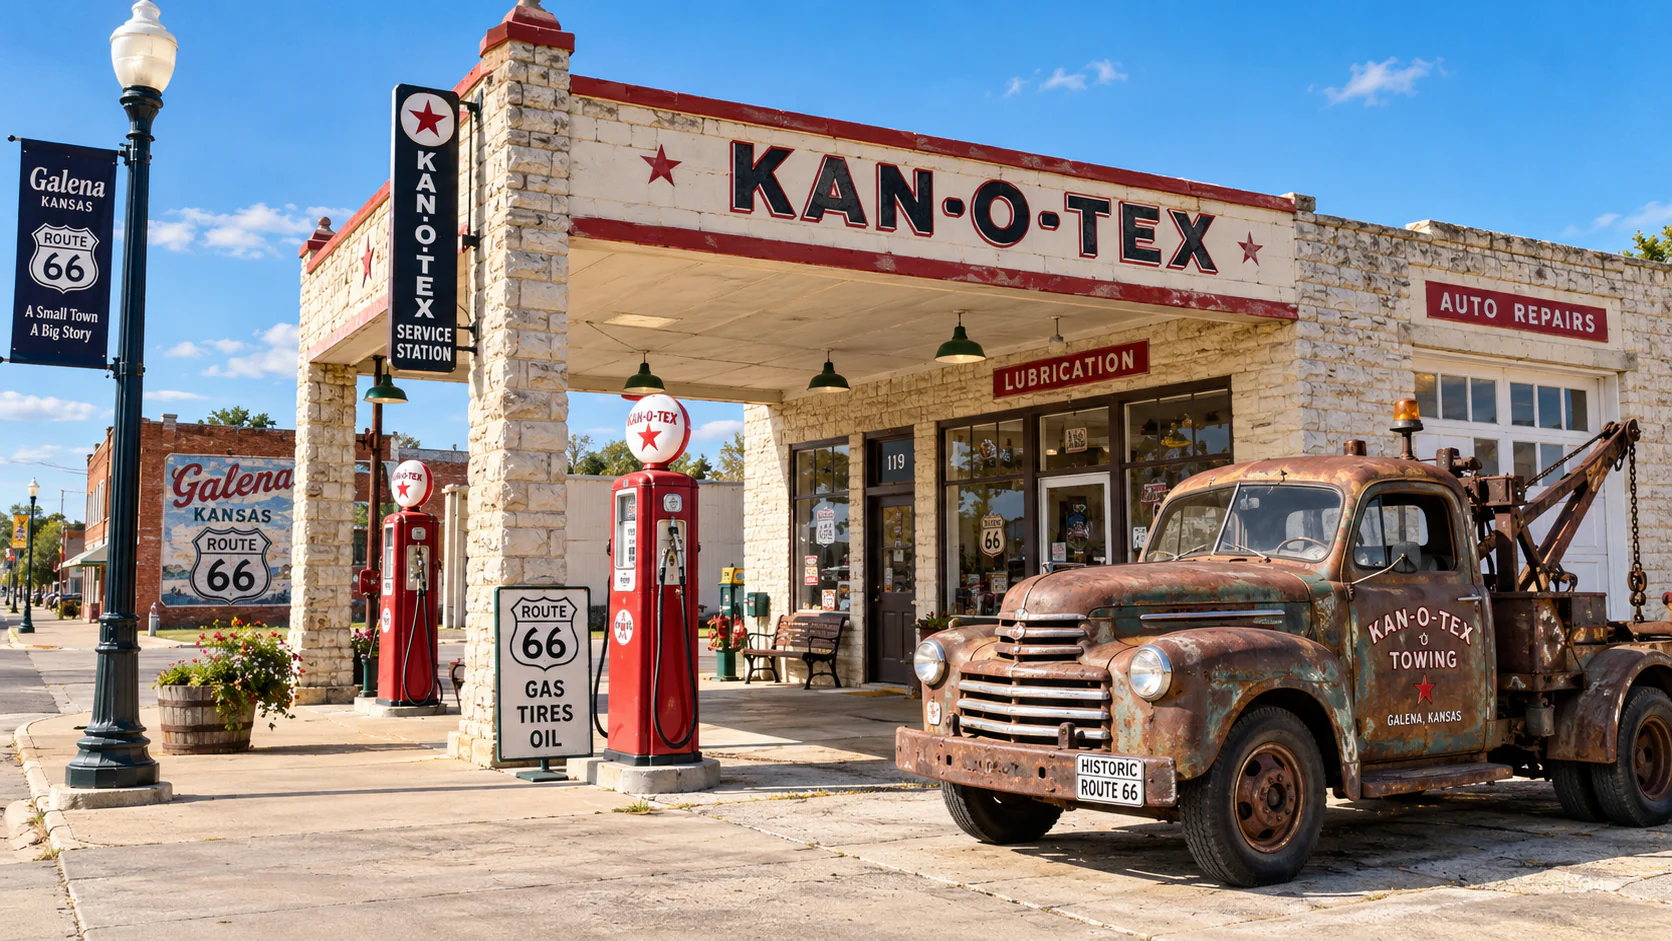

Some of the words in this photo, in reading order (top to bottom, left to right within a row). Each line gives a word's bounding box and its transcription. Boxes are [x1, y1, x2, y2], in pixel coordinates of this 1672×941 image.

[29, 166, 106, 198] Galena
[41, 195, 94, 213] KANSAS
[44, 231, 88, 247] ROUTE
[43, 251, 85, 283] 66
[24, 304, 34, 318] A
[36, 304, 67, 321] Small
[69, 307, 99, 324] Town
[1440, 291, 1498, 319] AUTO
[1514, 302, 1596, 333] REPAIRS
[30, 323, 39, 337] A
[41, 323, 60, 341] Big
[62, 325, 92, 344] Story
[396, 323, 452, 343] SERVICE
[396, 343, 452, 362] STATION
[1005, 349, 1134, 391] LUBRICATION
[887, 453, 905, 471] 119
[171, 462, 296, 508] Galena
[194, 507, 272, 523] KANSAS
[207, 537, 257, 551] ROUTE
[985, 530, 1001, 549] 66
[207, 558, 256, 592] 66
[522, 605, 567, 618] ROUTE
[1368, 605, 1474, 646] KAN-O-TEX
[522, 626, 566, 659] 66
[1389, 650, 1458, 670] TOWING
[525, 679, 565, 698] GAS
[517, 704, 574, 723] TIRES
[1387, 712, 1426, 727] GALENA,
[1428, 710, 1462, 723] KANSAS
[530, 729, 562, 748] OIL
[1081, 758, 1138, 777] HISTORIC
[1081, 778, 1118, 799] ROUTE
[1122, 782, 1138, 800] 66
